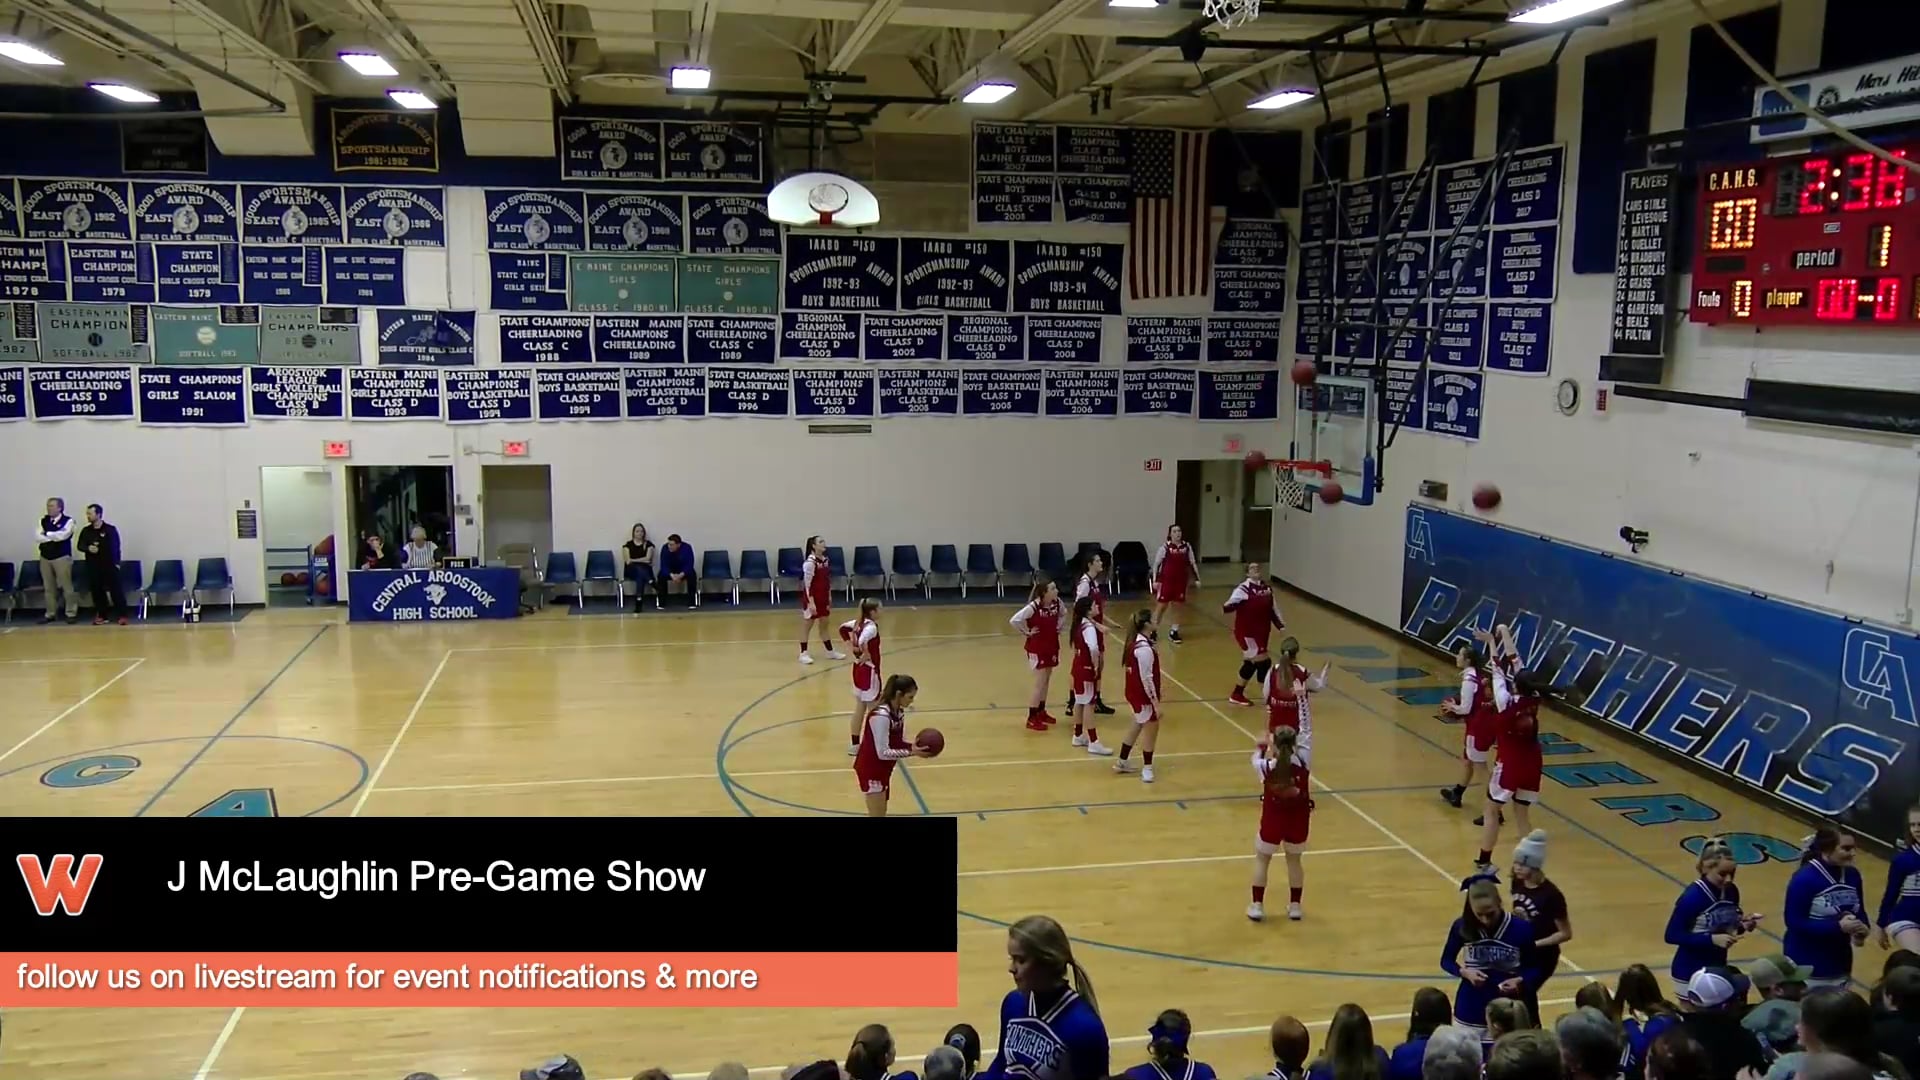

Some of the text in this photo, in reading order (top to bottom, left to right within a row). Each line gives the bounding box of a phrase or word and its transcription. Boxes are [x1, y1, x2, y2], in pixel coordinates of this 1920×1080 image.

[1631, 175, 1668, 189] PLAYERS
[1710, 169, 1758, 189] C.A.H.S.
[23, 182, 128, 215] GOOD SPORTSMANSHIP
[1512, 192, 1532, 201] CLASS
[1644, 198, 1666, 210] GIRLS
[33, 212, 62, 220] EAST
[1880, 226, 1891, 267] 1
[1796, 248, 1835, 269] period
[687, 265, 770, 273] STATE CHAMPIONS
[789, 256, 894, 287] SPORTSMANSHIP AWARD
[1017, 259, 1118, 291] SPORTSMANSHIP AWARD
[823, 277, 860, 290] 1992-93
[802, 295, 880, 308] BOYS BASKETBALL
[1698, 291, 1720, 307] fouls
[1734, 281, 1752, 316] 0
[1766, 289, 1803, 308] player
[1030, 298, 1105, 312] BOYS BASKETBALL
[501, 318, 590, 327] STATE CHAMPIONS
[798, 314, 843, 322] REGIONAL
[964, 317, 1008, 325] REGIONAL
[795, 323, 846, 331] CHAMPION
[960, 326, 1012, 334] CHAMPIONS
[508, 330, 582, 338] CHEERLEADING
[786, 332, 855, 340] CHEERLEADING
[523, 342, 568, 350] CLASS C
[800, 340, 828, 348] CLASS
[966, 343, 993, 351] CLASS
[30, 371, 130, 380] STATE CHAMPIONS
[351, 370, 437, 379] EASTERN MAINE
[538, 372, 619, 381] STATE CHAMPIONS
[795, 371, 836, 379] EASTERN
[991, 373, 1040, 381] CHAMPIONS
[141, 375, 242, 384] STATE CHAMPIONS
[277, 376, 317, 384] LEAGUE
[364, 380, 425, 388] CHAMPIONS
[805, 380, 863, 388] CHAMPIONS
[40, 381, 122, 390] CHEERLEADING
[253, 384, 342, 393] GIRLS VOLLEYBALL
[538, 383, 619, 392] BOYS BASKETBALL
[964, 382, 1039, 391] BOYS BASKETBALL
[57, 392, 107, 401] CLASS D
[147, 391, 236, 400] GIRLS SLALOM
[267, 392, 327, 401] CHAMPIONS
[352, 389, 439, 397] GIRLS BASKETBALL
[981, 392, 1009, 400] CLASS
[371, 399, 403, 407] CLASS
[560, 394, 600, 403] CLASS D
[814, 397, 855, 405] CLASS D
[71, 404, 96, 412] 1990
[182, 408, 204, 416] 1991
[384, 408, 406, 416] 1993
[1145, 460, 1161, 470] EXIT
[373, 571, 496, 612] CENTRAL AROOSTOOK
[393, 607, 477, 620] HIGH SCHOOL
[1402, 576, 1907, 815] PANTHERS
